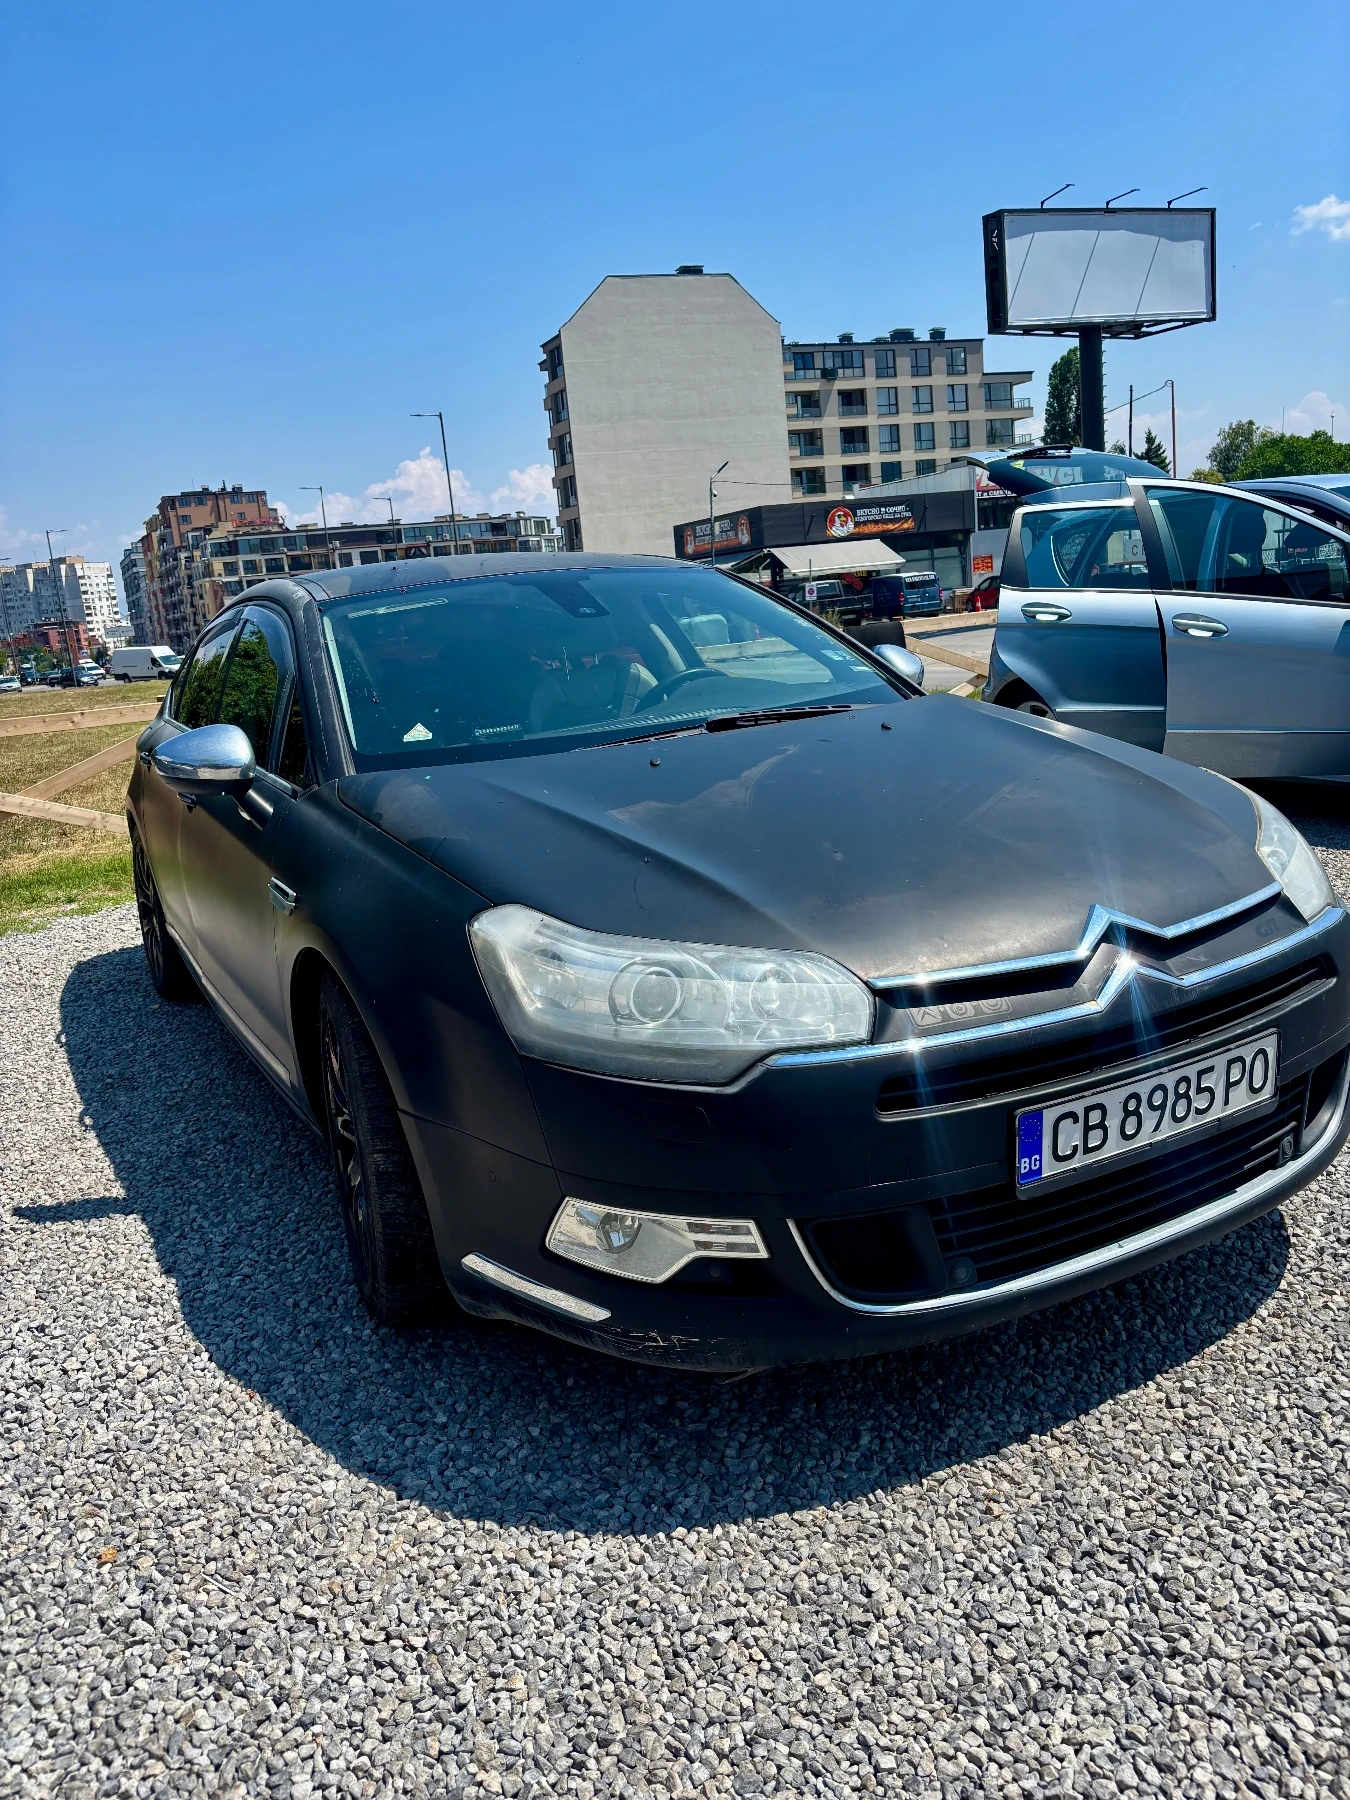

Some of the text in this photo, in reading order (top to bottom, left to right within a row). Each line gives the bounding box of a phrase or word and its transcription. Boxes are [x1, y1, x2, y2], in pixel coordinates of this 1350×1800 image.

[856, 507, 880, 517] ВКУСНО
[886, 505, 906, 514] СОЧНО
[1119, 1065, 1216, 1142] 8985
[1020, 1154, 1040, 1174] BG
